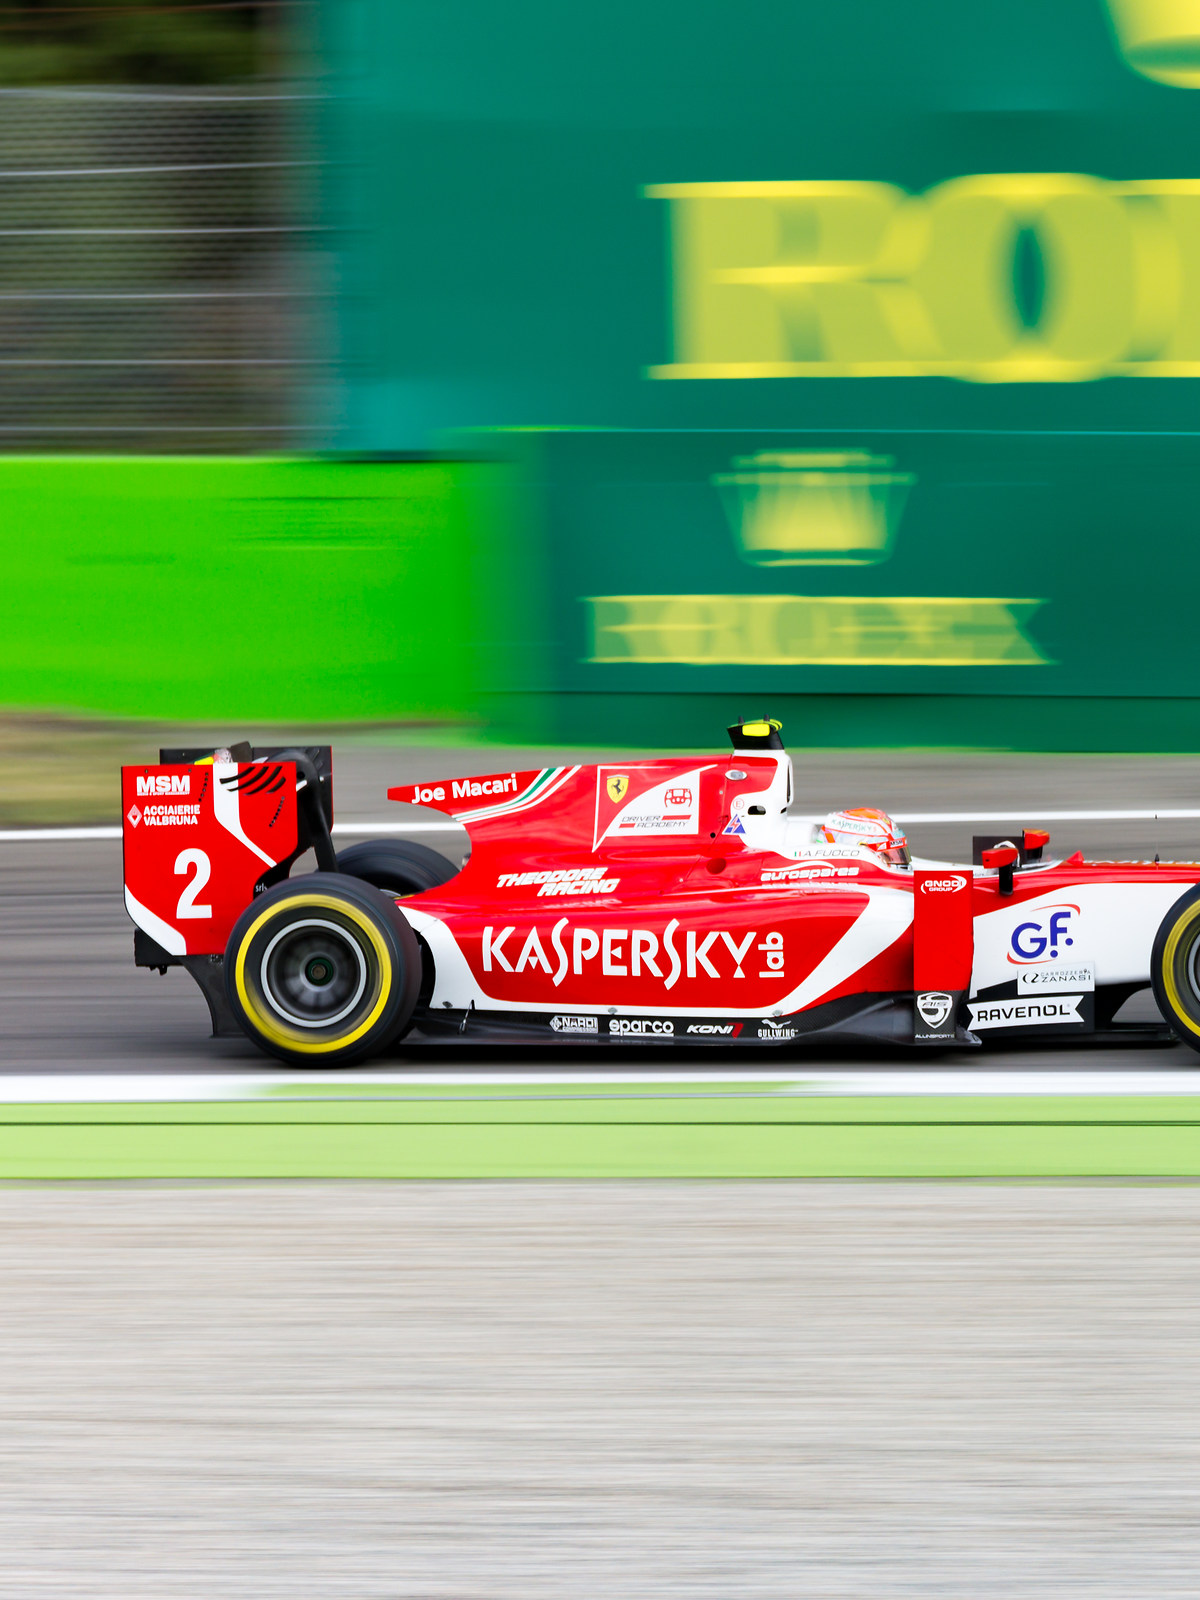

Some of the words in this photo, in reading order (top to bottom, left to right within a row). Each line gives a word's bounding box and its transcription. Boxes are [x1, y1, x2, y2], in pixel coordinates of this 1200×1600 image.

[136, 775, 191, 793] MSM
[412, 786, 446, 804] Joe
[452, 773, 518, 799] Macari
[143, 804, 201, 816] ACCIAIERIE
[143, 815, 199, 826] VALBRUNA
[621, 815, 661, 823] DRIVER
[636, 821, 688, 829] ACADEMY
[496, 867, 609, 888] THEODORE
[760, 867, 860, 882] eurospares
[174, 848, 212, 919] 2
[537, 878, 621, 897] RACING
[1011, 911, 1074, 959] G.F.
[482, 917, 757, 991] KASPERSKY
[757, 931, 785, 978] lab
[1040, 969, 1091, 977] CARROZZERA
[1041, 975, 1091, 983] ZANASI
[977, 1004, 1071, 1022] RAVENOL
[608, 1019, 675, 1036] sparco
[686, 1024, 734, 1034] KONI
[757, 1028, 796, 1038] GULLWING
